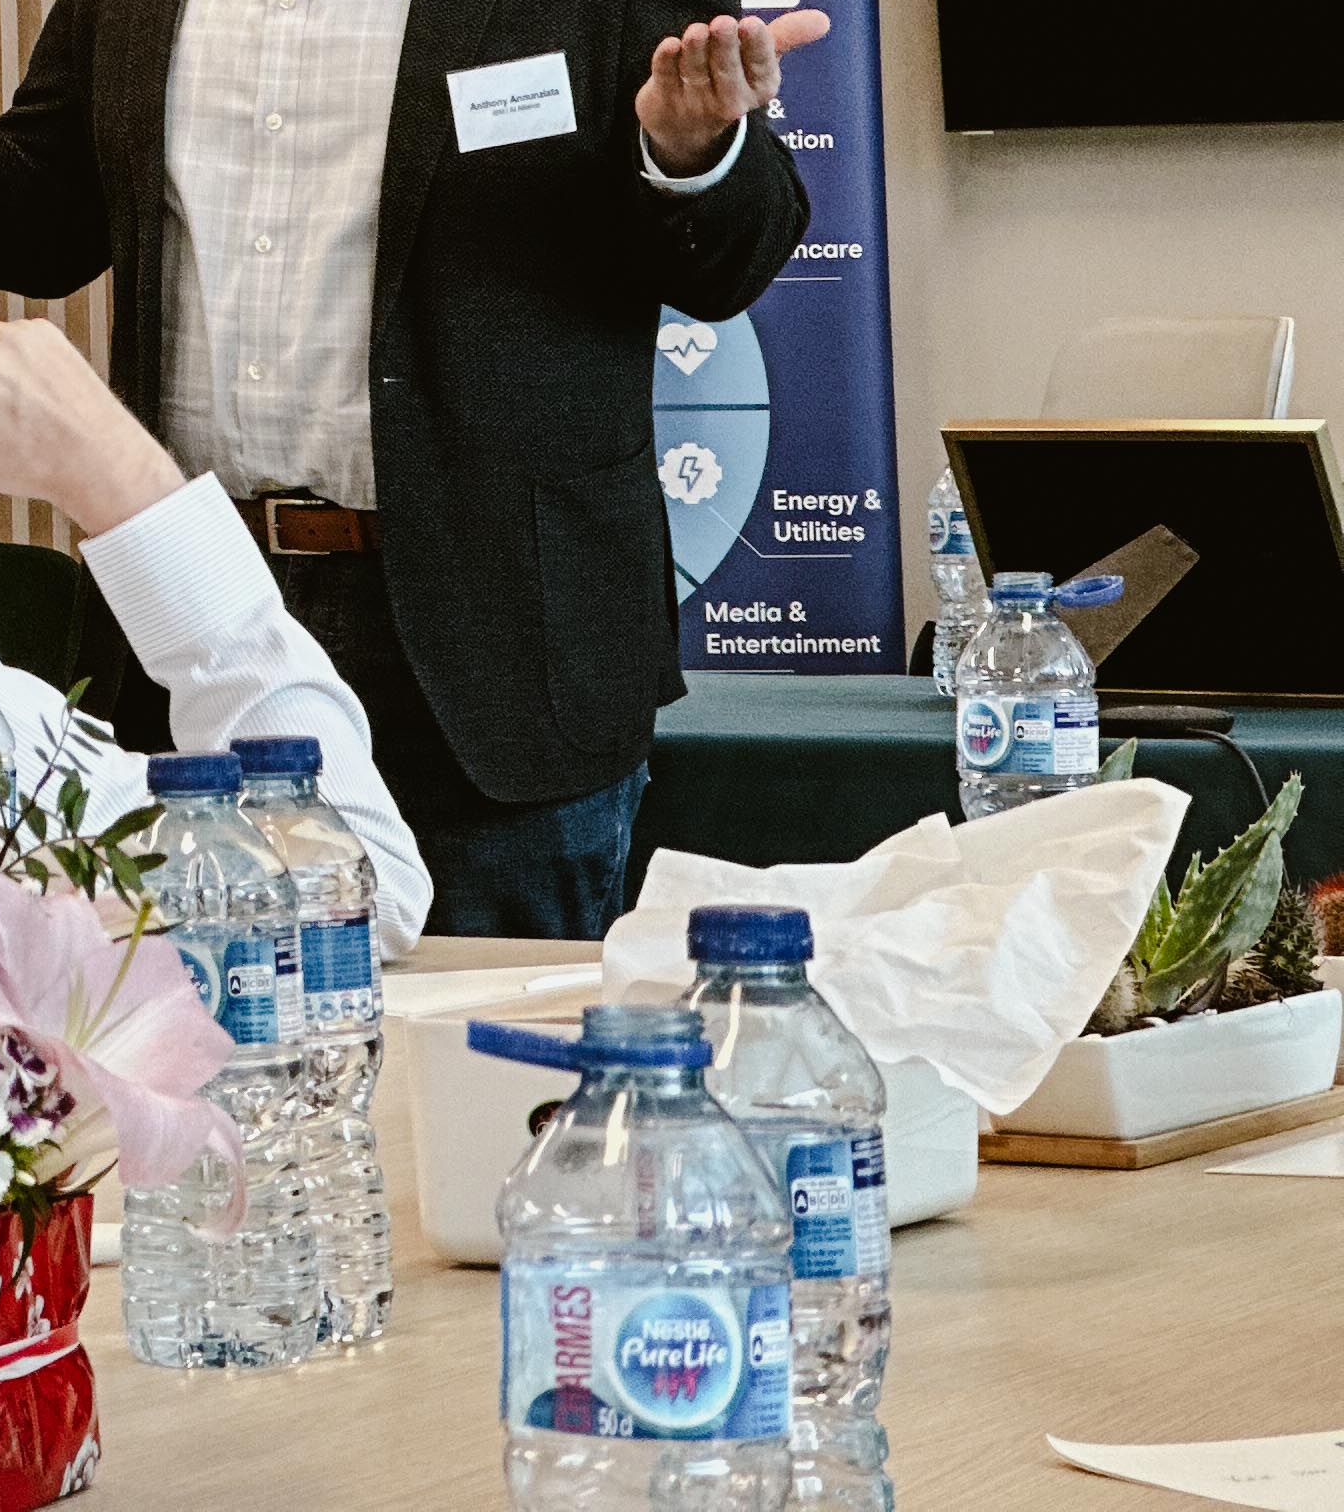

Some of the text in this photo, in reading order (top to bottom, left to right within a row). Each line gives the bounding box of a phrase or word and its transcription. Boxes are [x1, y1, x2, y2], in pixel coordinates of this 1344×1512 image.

[470, 98, 507, 111] Anthony
[767, 98, 786, 119] &
[773, 488, 882, 516] Energy &
[774, 521, 865, 542] Utilities
[705, 600, 807, 623] Media &
[706, 633, 882, 655] Entertainment
